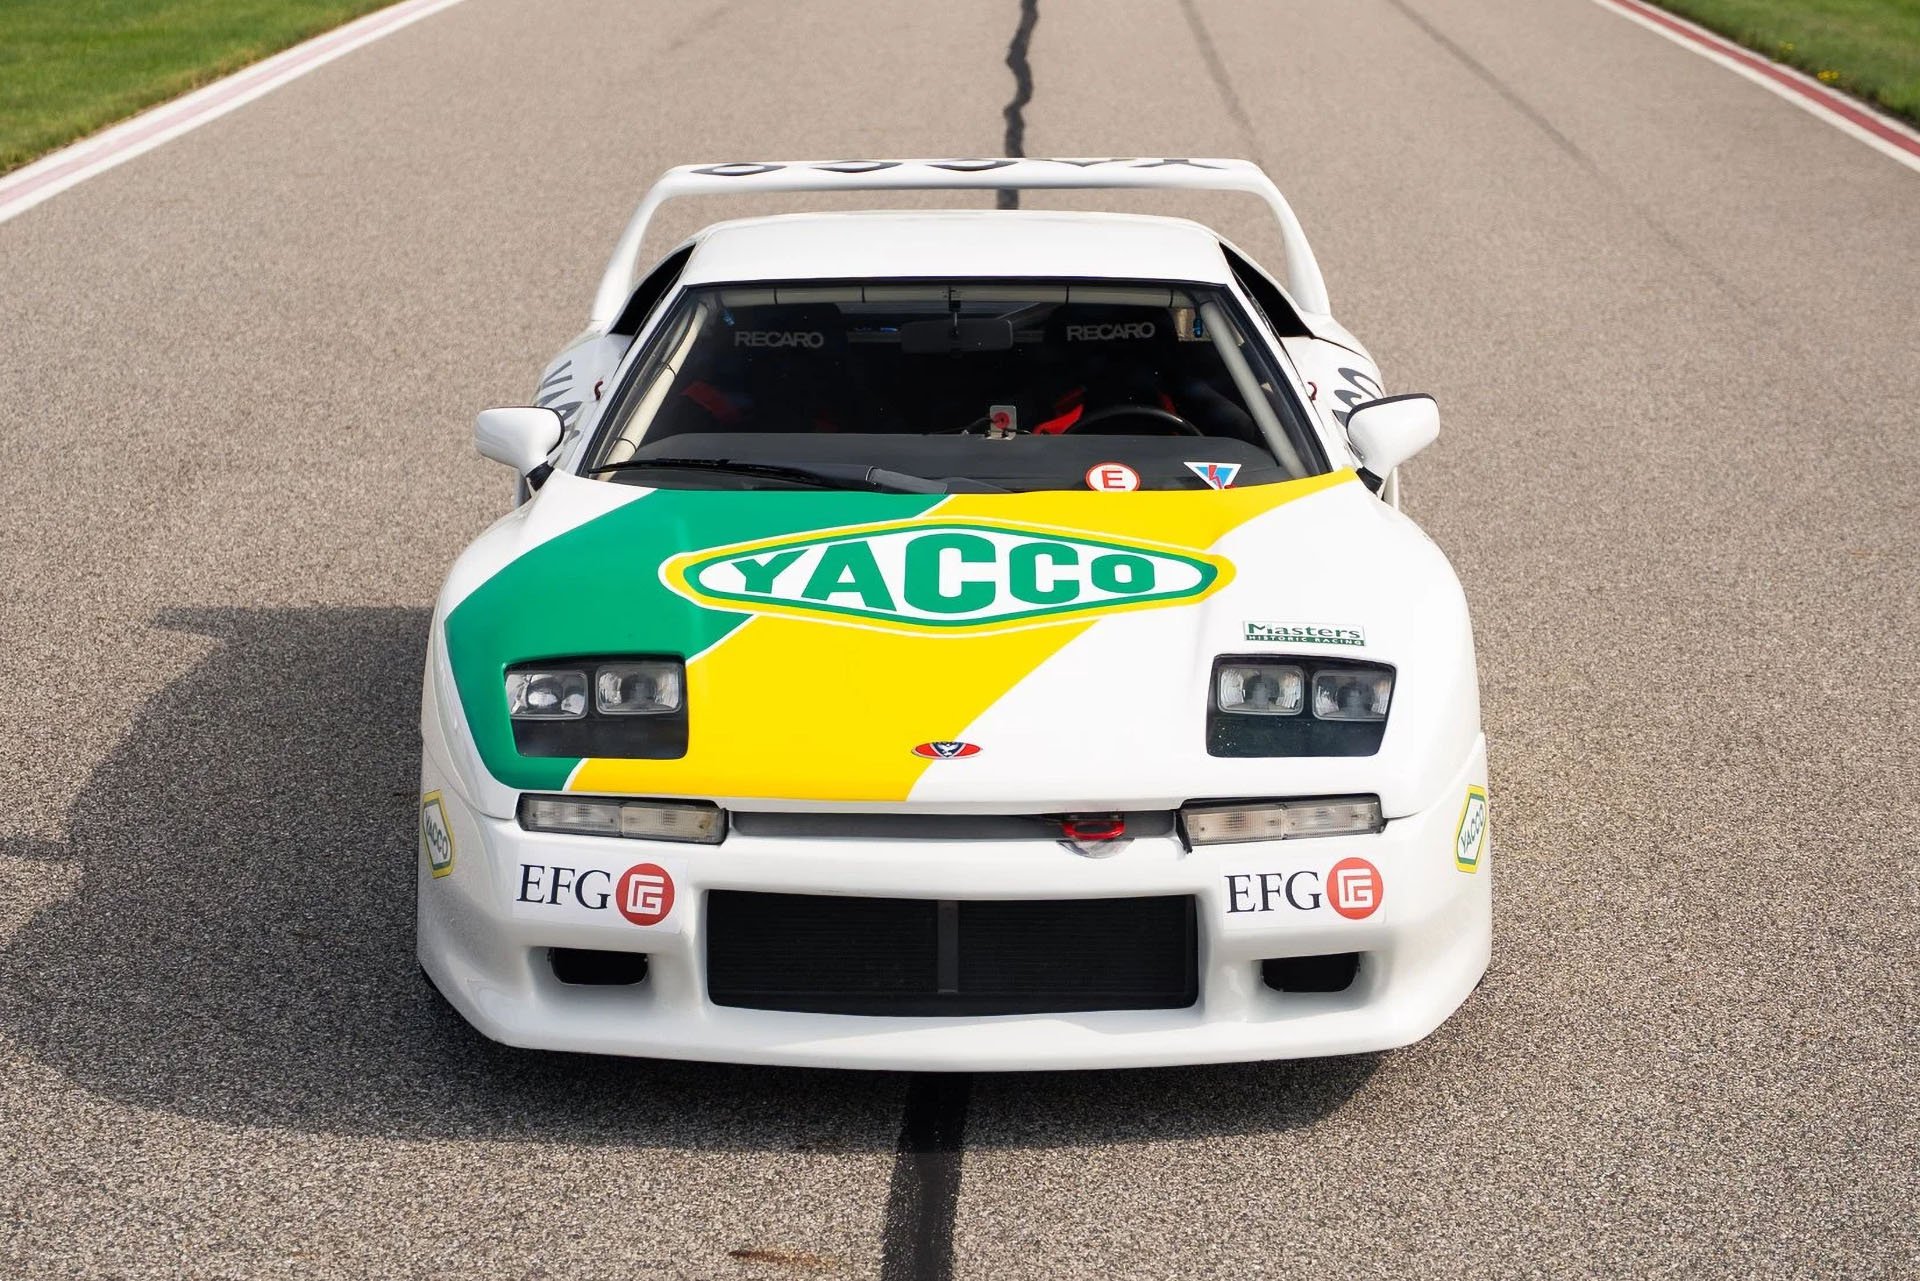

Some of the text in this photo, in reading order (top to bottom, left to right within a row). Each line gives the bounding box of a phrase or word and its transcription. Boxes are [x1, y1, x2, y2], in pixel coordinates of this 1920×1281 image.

[733, 330, 825, 349] RECARO
[1066, 321, 1156, 342] RECARO
[1101, 470, 1126, 489] E
[730, 532, 1155, 615] YACCO
[1247, 623, 1361, 639] Masters
[1248, 634, 1363, 646] HISTORIC RACING
[516, 863, 612, 910] EFG
[1224, 870, 1322, 914] EFG
